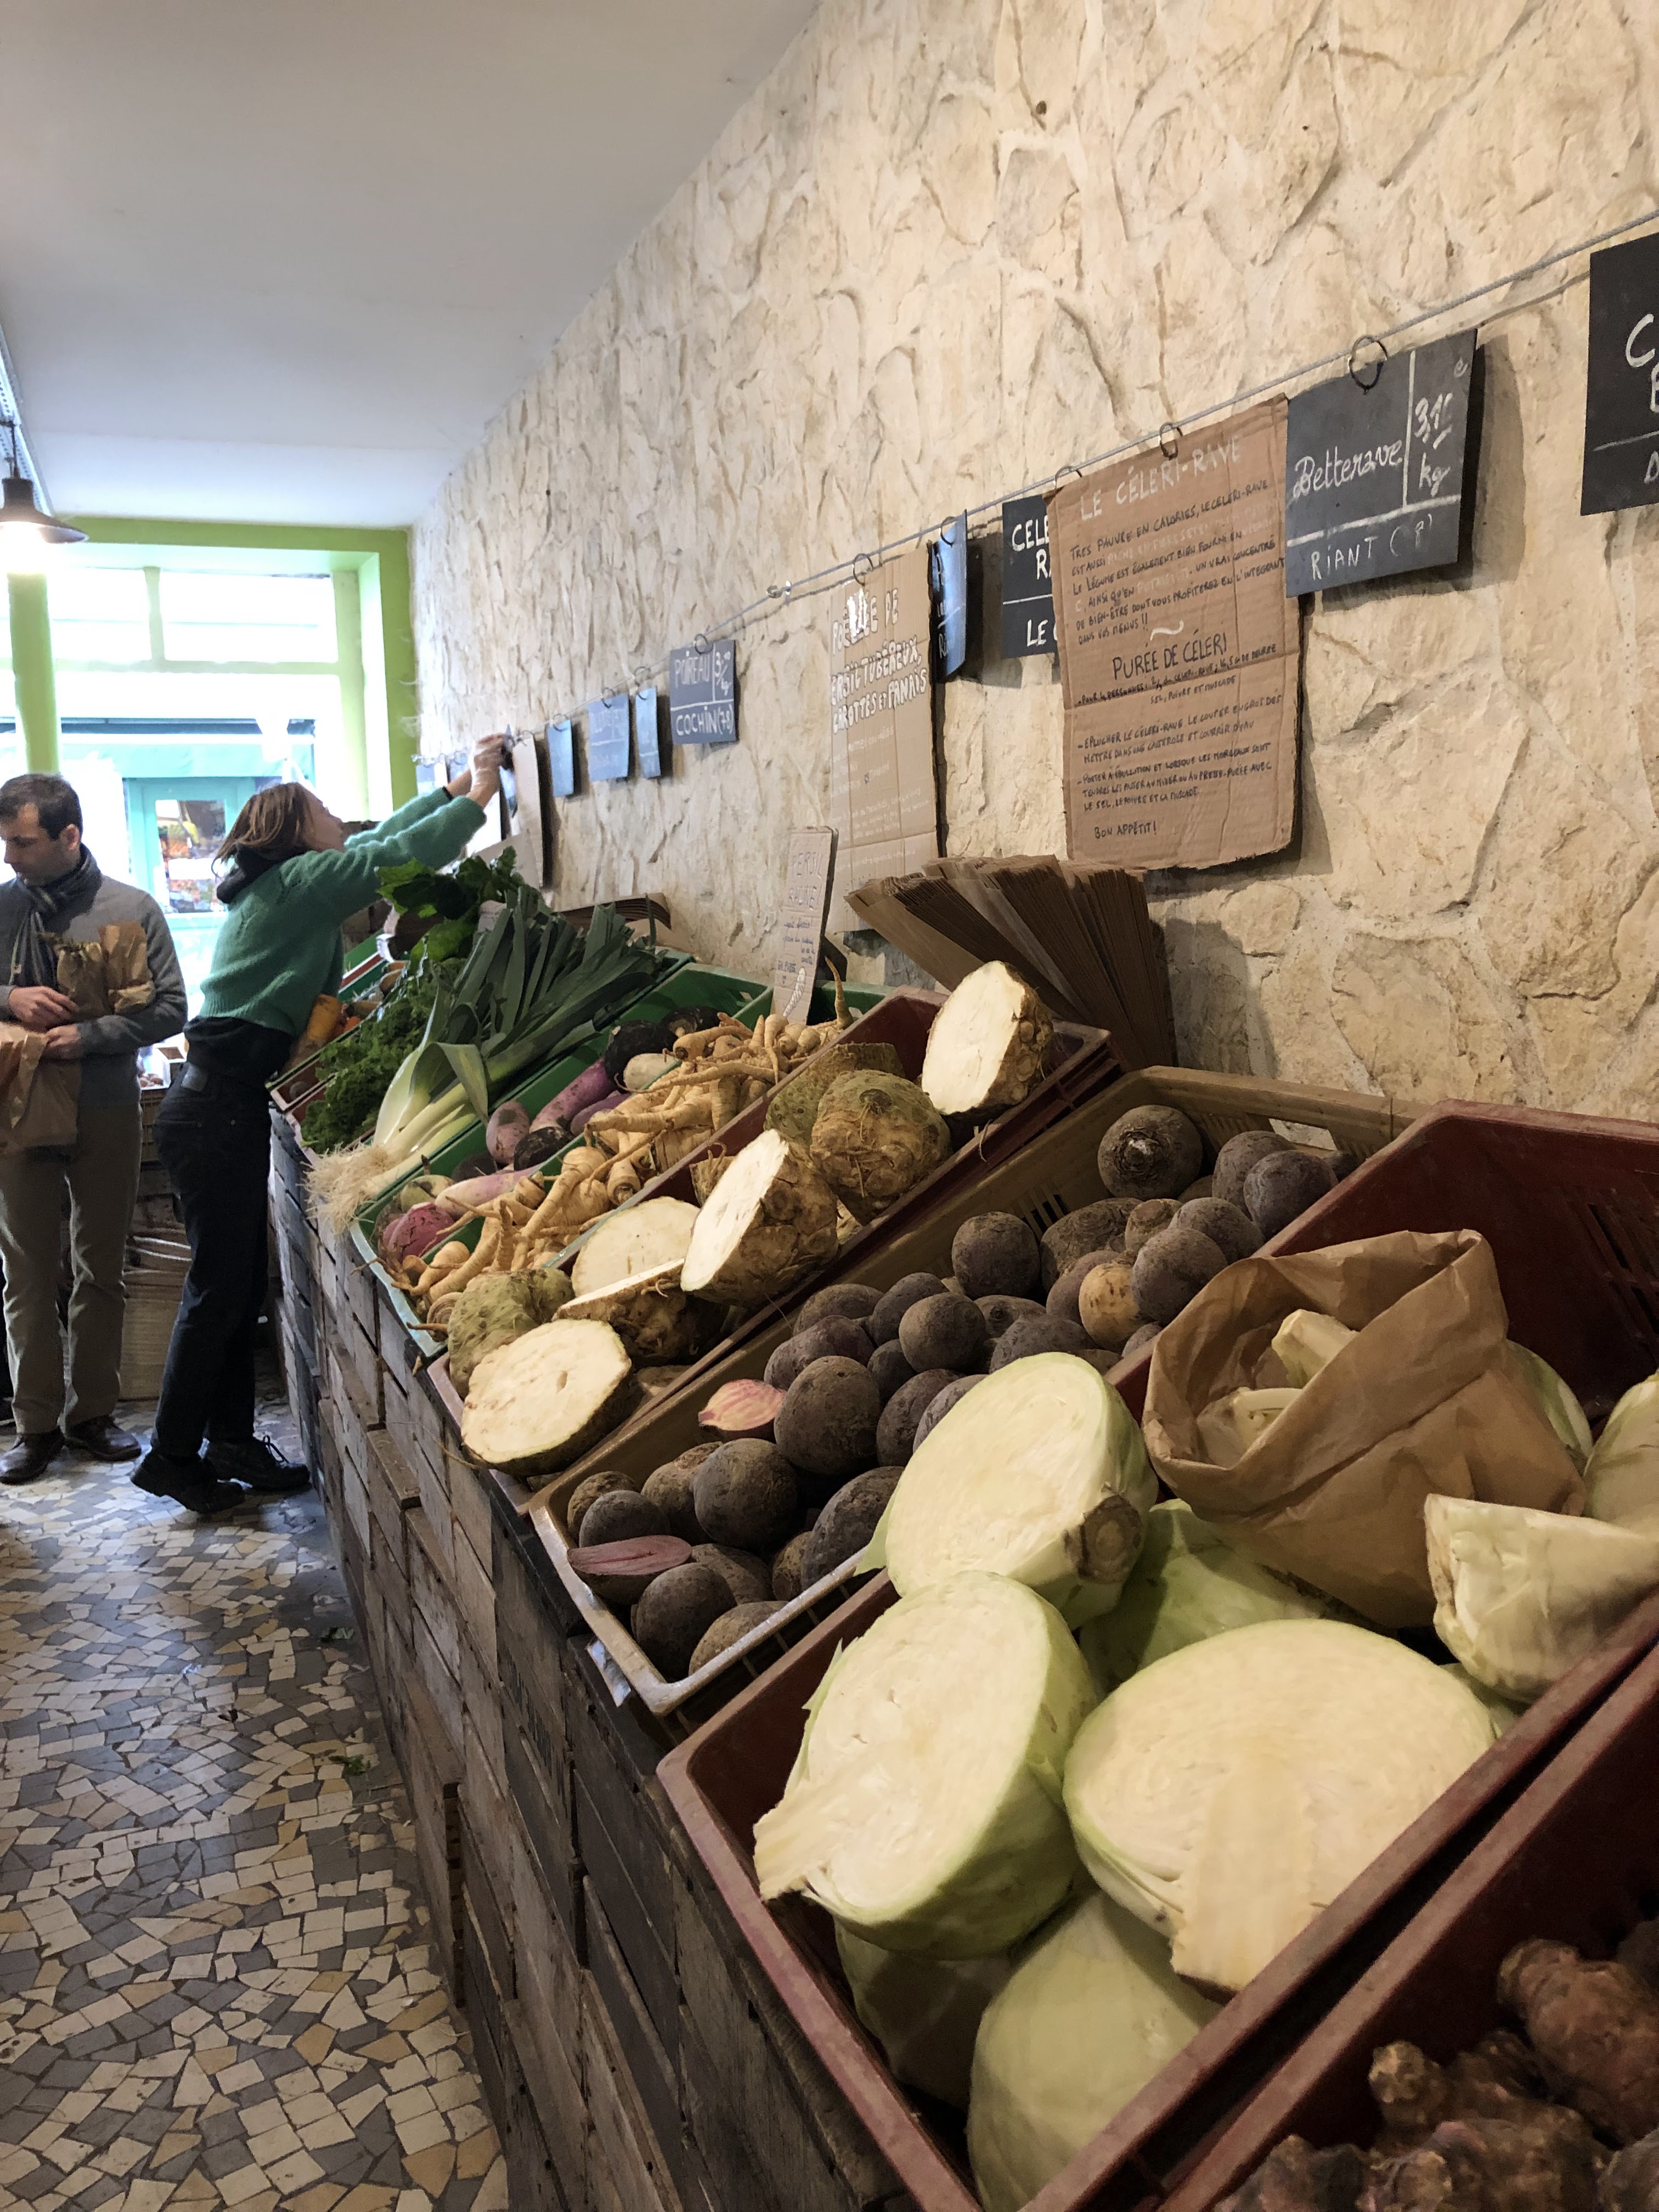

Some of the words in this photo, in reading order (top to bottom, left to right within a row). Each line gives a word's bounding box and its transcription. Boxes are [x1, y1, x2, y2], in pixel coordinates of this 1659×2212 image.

[1293, 439, 1403, 498] Betterave
[1080, 489, 1103, 521] LE
[1012, 515, 1049, 551] CELE
[1097, 529, 1132, 552] PAUVRE
[1136, 522, 1150, 538] EN
[1071, 564, 1085, 577] EST
[1073, 583, 1082, 596] LE
[1116, 566, 1129, 579] EST
[1177, 544, 1196, 560] BIEN
[1230, 531, 1242, 542] EN
[1088, 592, 1108, 608] AINSI
[1196, 561, 1206, 572] UN
[1209, 555, 1231, 568] VRAI
[884, 588, 899, 628] DE
[1076, 619, 1085, 631] DE
[1132, 597, 1151, 613] DONT
[1152, 595, 1171, 607] VOUS
[1221, 575, 1233, 586] EN
[1026, 618, 1048, 647] LE
[1079, 631, 1094, 645] DANS
[1098, 626, 1109, 639] VOS
[1113, 618, 1138, 635] MENUS
[1112, 642, 1159, 680] PURÉE
[1164, 644, 1178, 668] DE
[1183, 628, 1227, 662] CÉLERI
[1194, 684, 1204, 693] ET
[833, 691, 877, 735] CAROTTES
[879, 691, 887, 712] ET
[1124, 729, 1133, 741] LE
[1188, 714, 1198, 725] LE
[1200, 706, 1229, 723] COUPER
[1233, 704, 1243, 714] EN
[1114, 748, 1132, 758] DANS
[1188, 730, 1198, 741] ET
[1111, 783, 1122, 793] LES
[1146, 780, 1155, 789] AU
[1188, 770, 1198, 781] AU
[1250, 759, 1272, 773] AVEC
[1153, 763, 1163, 772] ET
[1198, 753, 1211, 763] LES
[1084, 801, 1093, 811] LE
[1149, 793, 1159, 803] ET
[1094, 826, 1113, 839] BON
